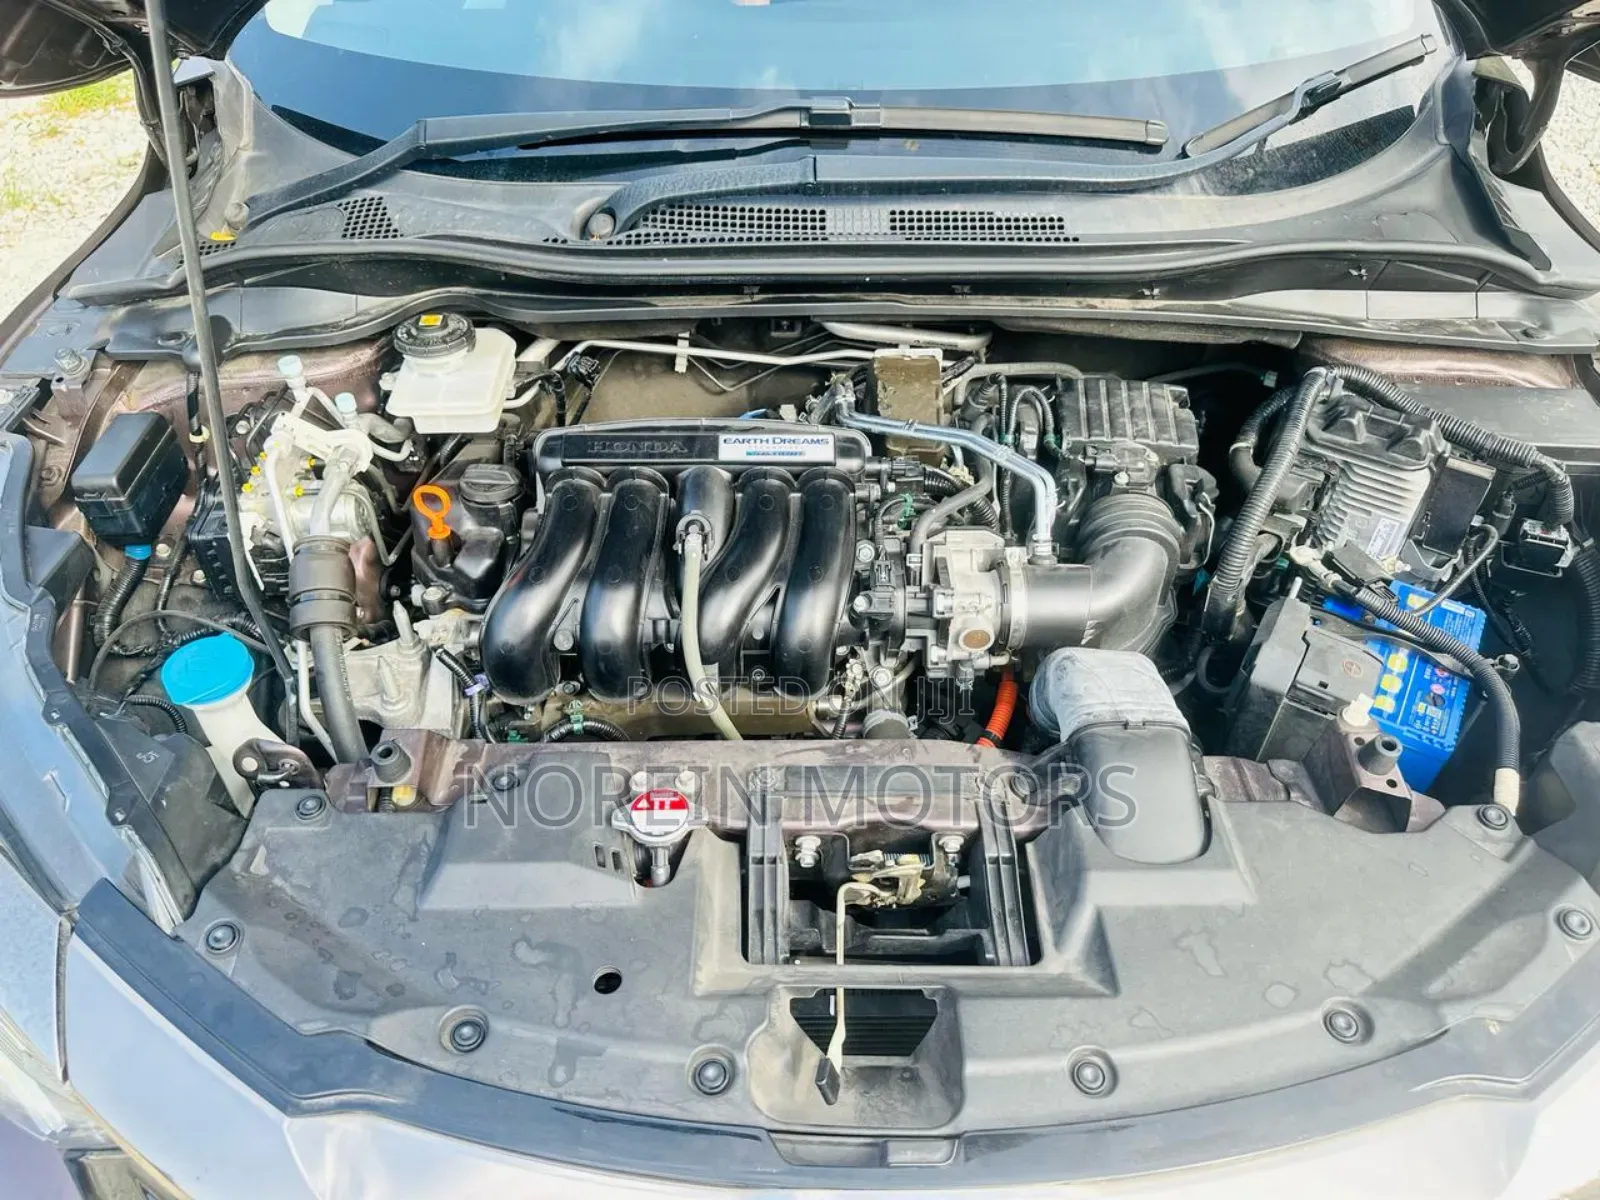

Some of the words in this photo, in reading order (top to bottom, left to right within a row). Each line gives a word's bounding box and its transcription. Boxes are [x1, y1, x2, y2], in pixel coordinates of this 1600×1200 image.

[723, 436, 770, 445] EARTH
[772, 436, 830, 445] DREAMS
[586, 440, 689, 453] HONDA
